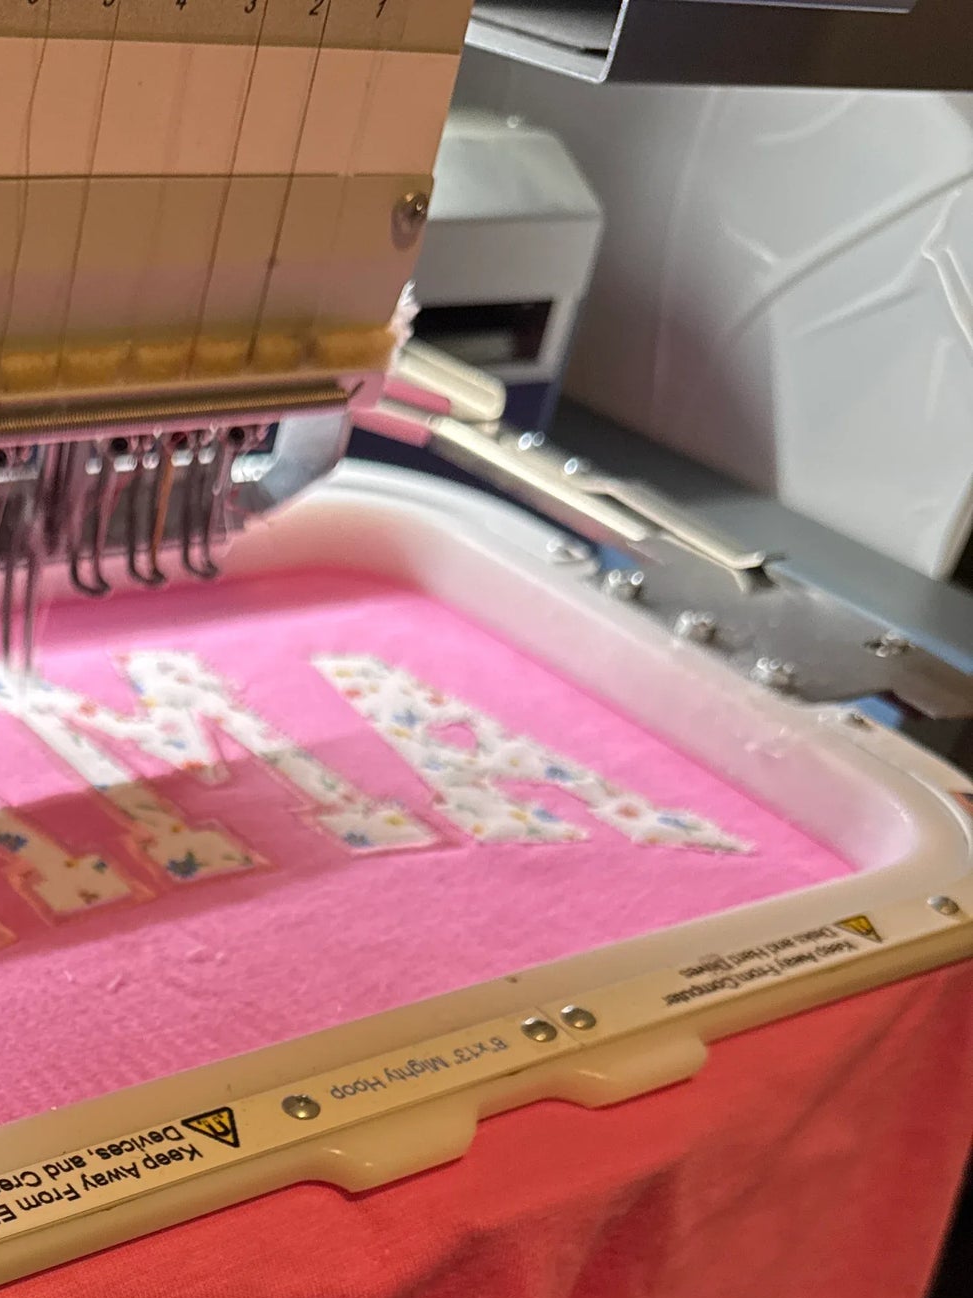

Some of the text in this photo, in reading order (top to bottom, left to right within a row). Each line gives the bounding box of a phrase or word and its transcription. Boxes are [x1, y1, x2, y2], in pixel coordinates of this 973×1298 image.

[243, 0, 257, 14] 3
[309, 0, 325, 16] 2
[375, 0, 388, 19] 1
[384, 1055, 451, 1083] Mighty
[330, 1075, 387, 1101] Hoop
[87, 1125, 185, 1161] Devices,
[42, 1155, 88, 1182] and
[144, 1144, 204, 1172] Keep
[81, 1161, 142, 1192] Away
[16, 1183, 82, 1212] From
